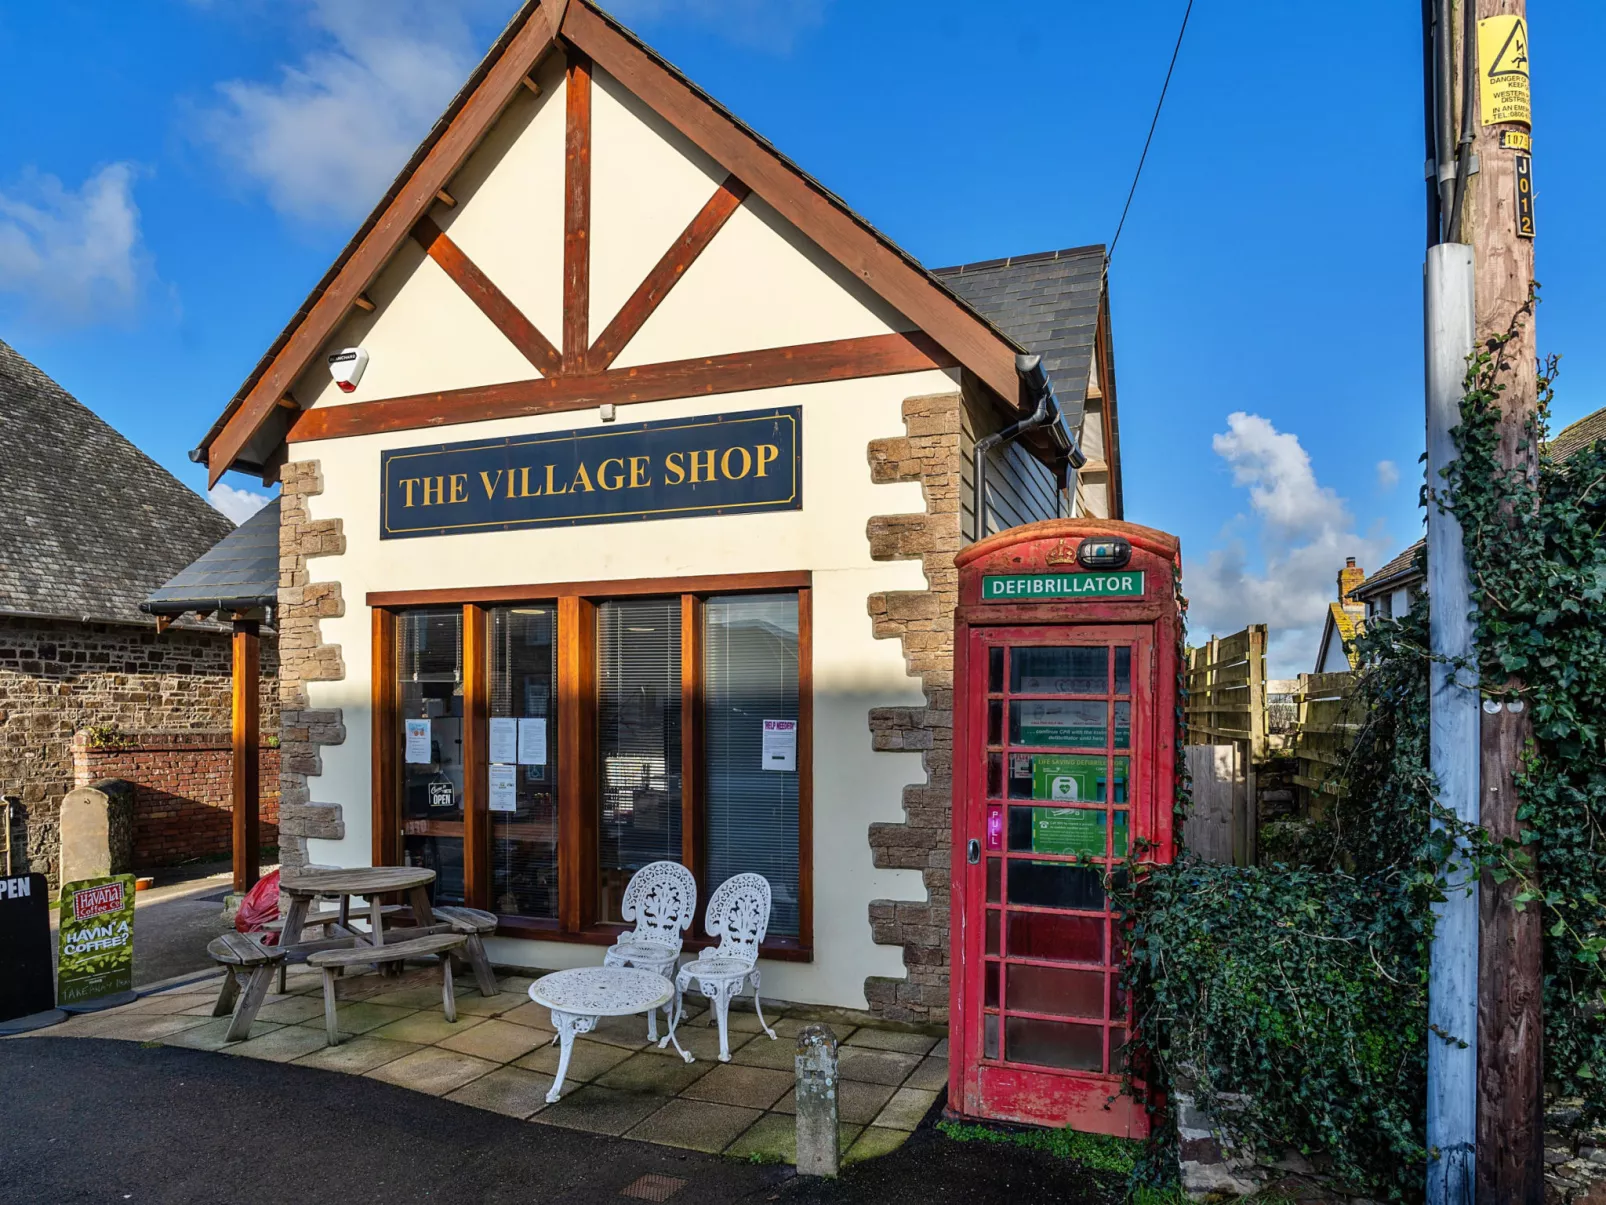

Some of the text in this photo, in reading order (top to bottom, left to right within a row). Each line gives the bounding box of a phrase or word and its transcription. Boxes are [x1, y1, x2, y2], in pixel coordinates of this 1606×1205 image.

[1490, 75, 1521, 85] DANGER
[1519, 159, 1531, 232] J012
[399, 444, 779, 508] THE VILLAGE SHOP
[992, 576, 1133, 595] DEFIBRILLATOR
[433, 794, 451, 805] OPEN
[991, 811, 999, 845] PULL
[117, 920, 129, 933] A
[63, 932, 129, 955] COFFEE?
